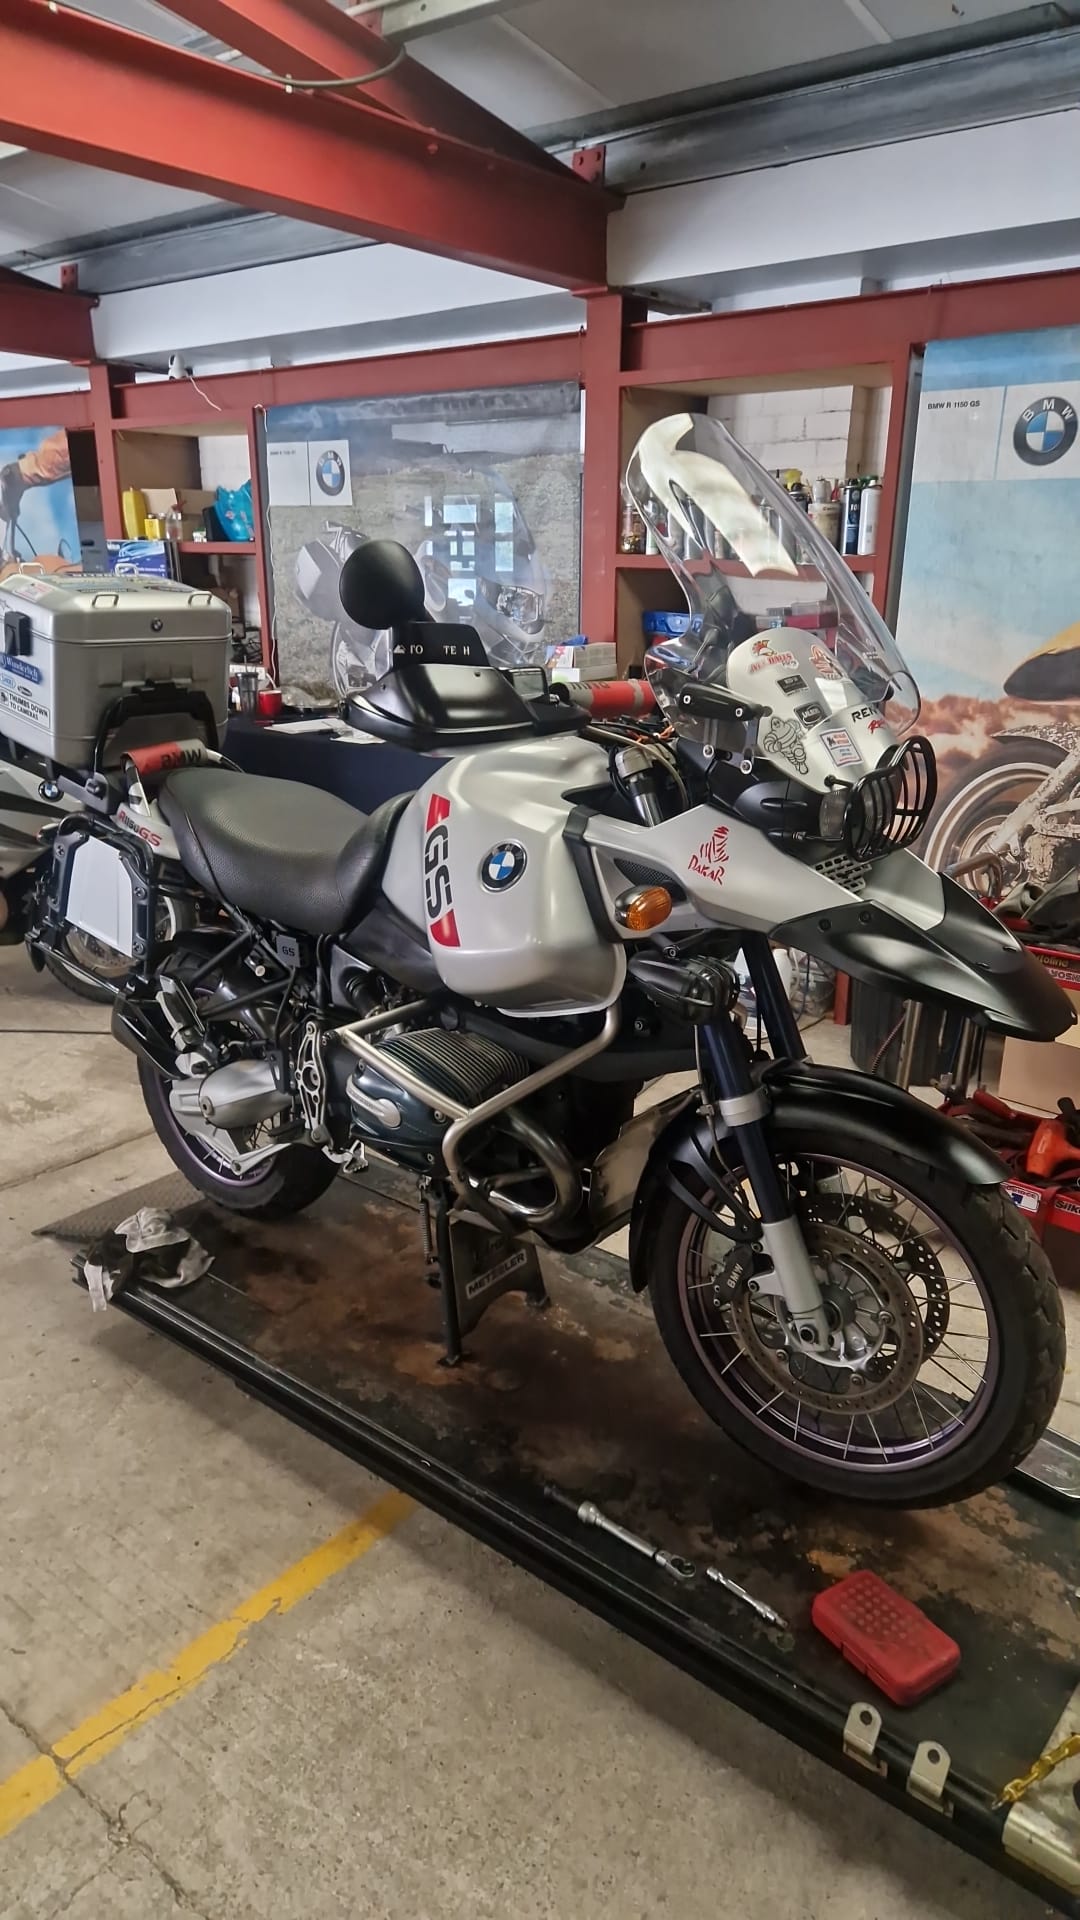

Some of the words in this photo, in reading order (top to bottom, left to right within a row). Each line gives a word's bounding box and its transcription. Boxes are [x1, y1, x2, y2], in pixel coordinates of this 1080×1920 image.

[927, 402, 944, 410] BMW
[970, 400, 981, 408] GS
[1022, 399, 1074, 421] BMW
[17, 705, 39, 721] CAMERAS
[31, 703, 48, 718] DOWN
[161, 748, 202, 770] BMW
[424, 824, 453, 919] GS
[688, 855, 725, 885] DAKAR
[282, 945, 295, 957] GS
[726, 1263, 744, 1289] BMW
